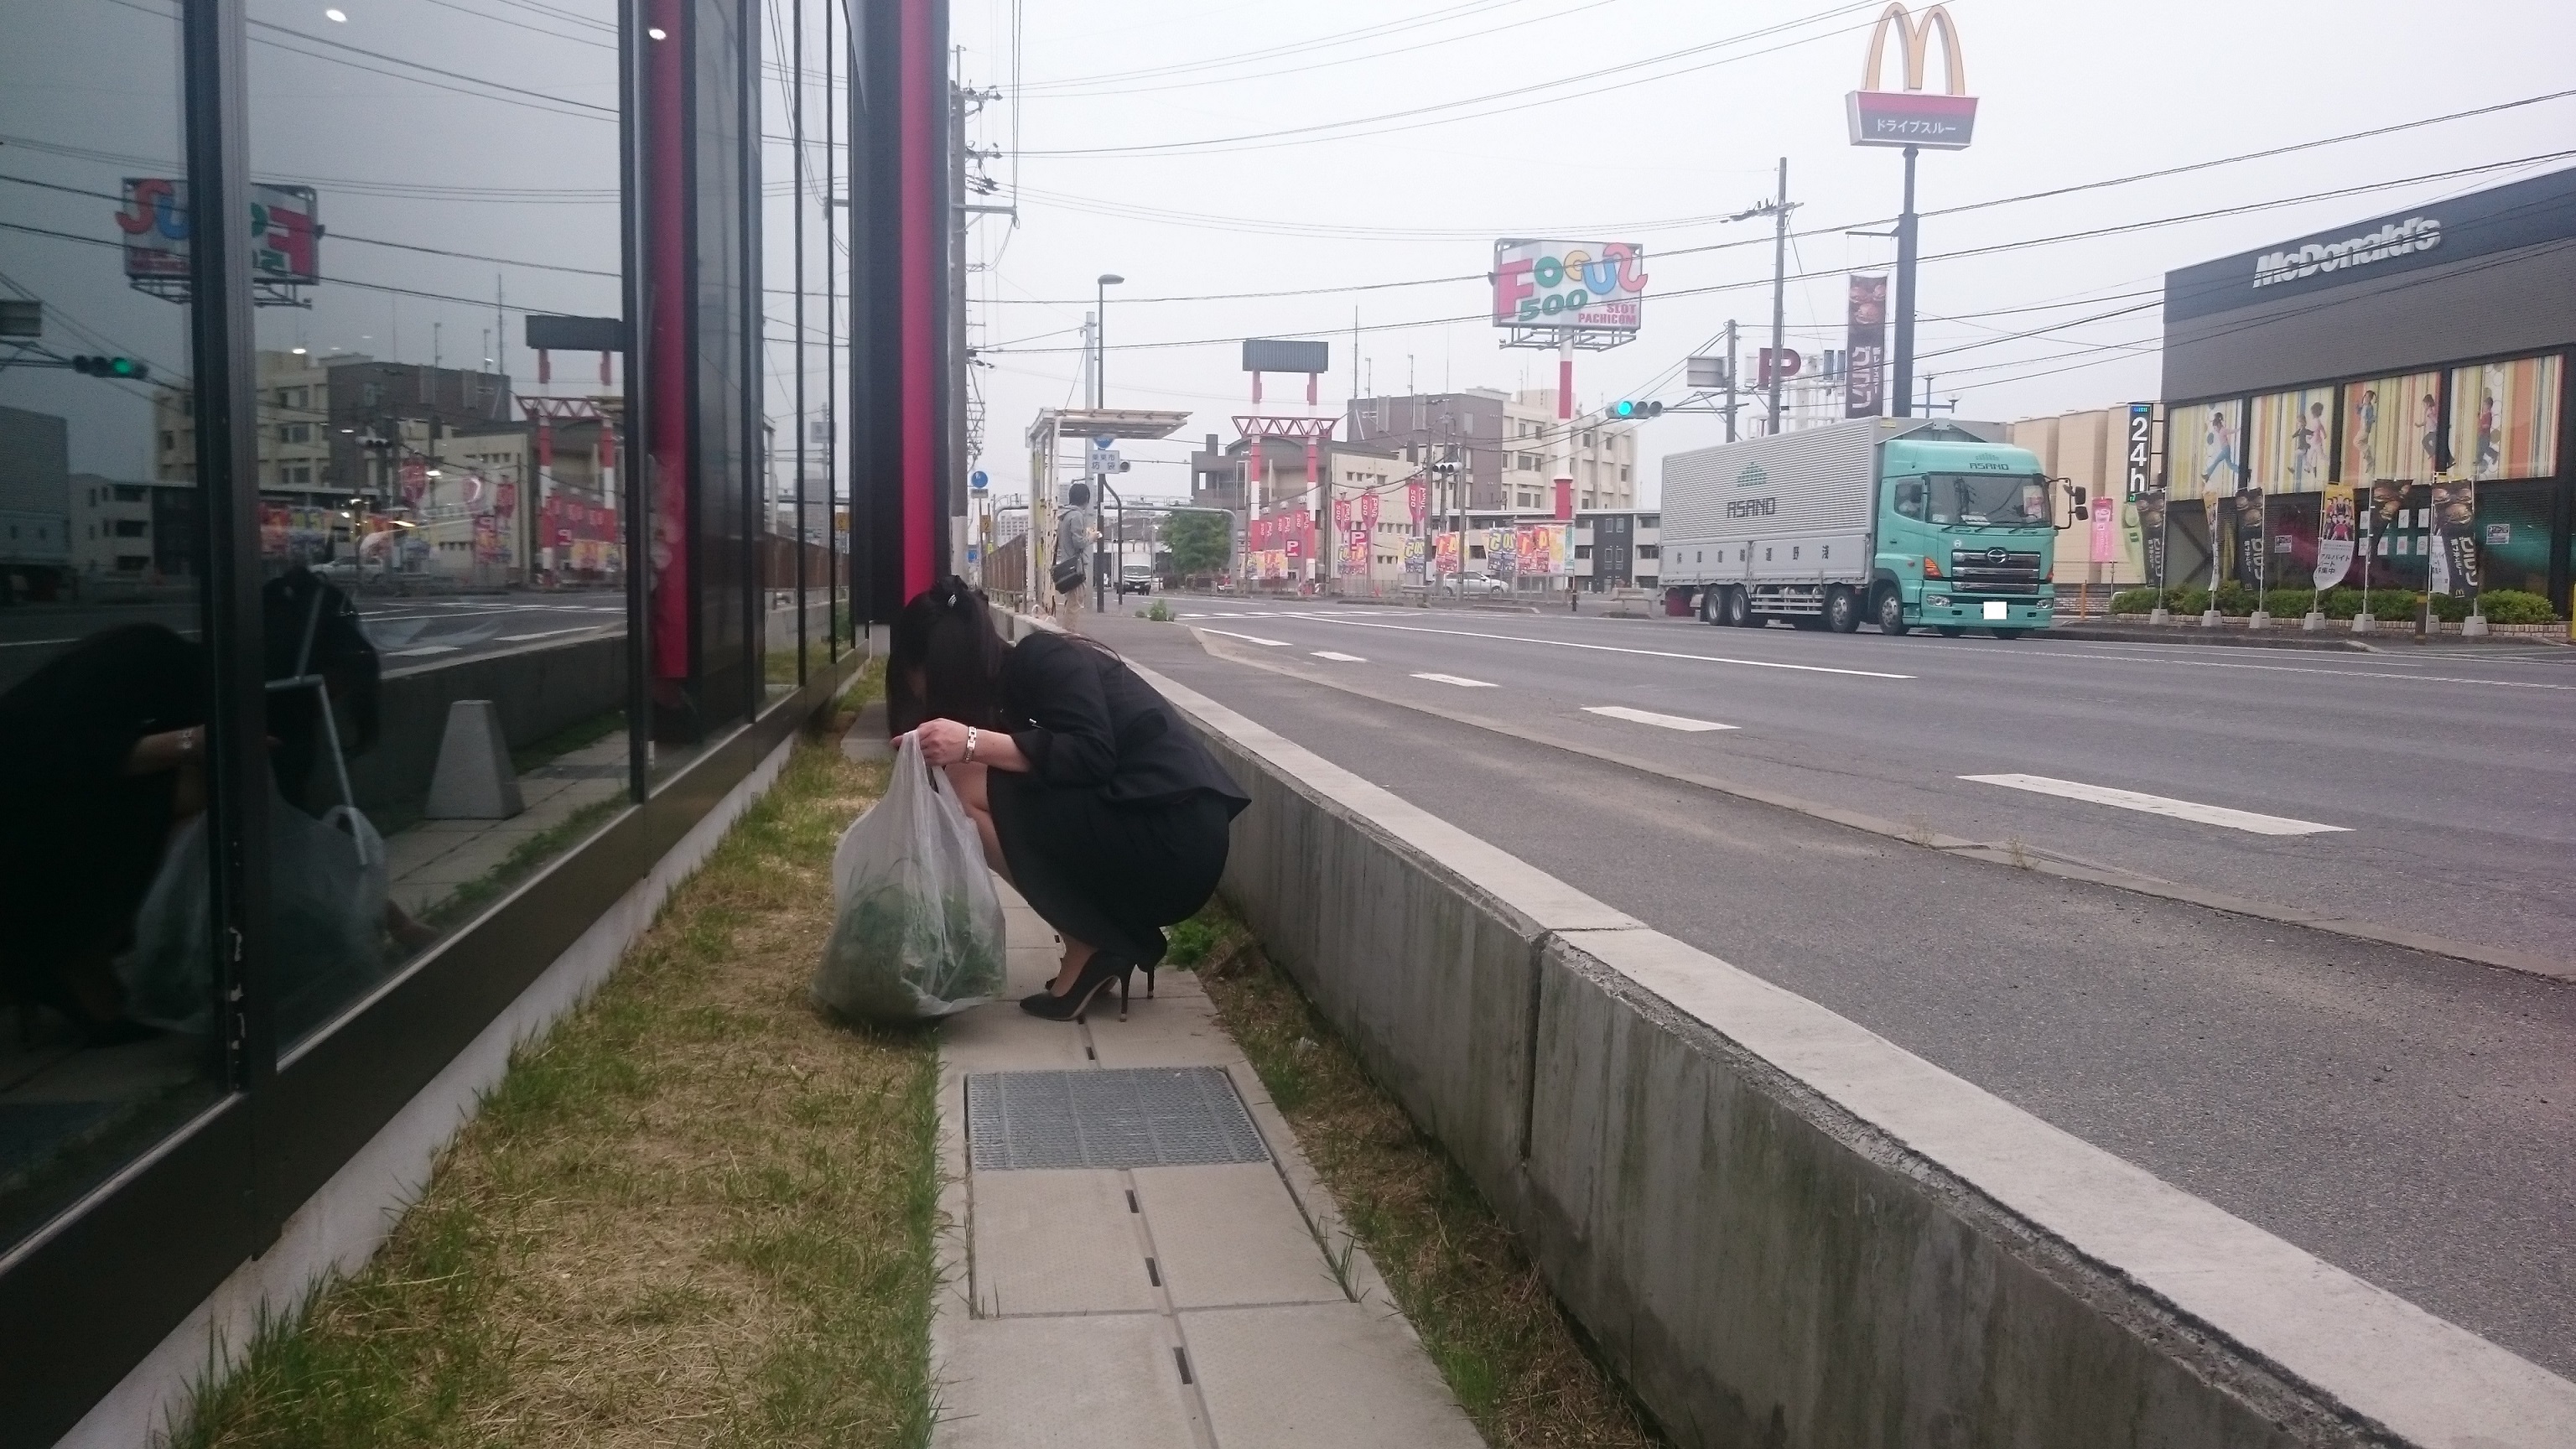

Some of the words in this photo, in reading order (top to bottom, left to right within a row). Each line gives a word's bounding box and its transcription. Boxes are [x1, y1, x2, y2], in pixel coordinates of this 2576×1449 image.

[1877, 118, 1956, 134] ドライブスルー
[2252, 216, 2441, 288] McDonald's
[1519, 288, 1588, 321] 500
[1607, 303, 1637, 314] SLOT
[1970, 462, 2009, 470] ASANO
[1727, 496, 1776, 518] ASANO
